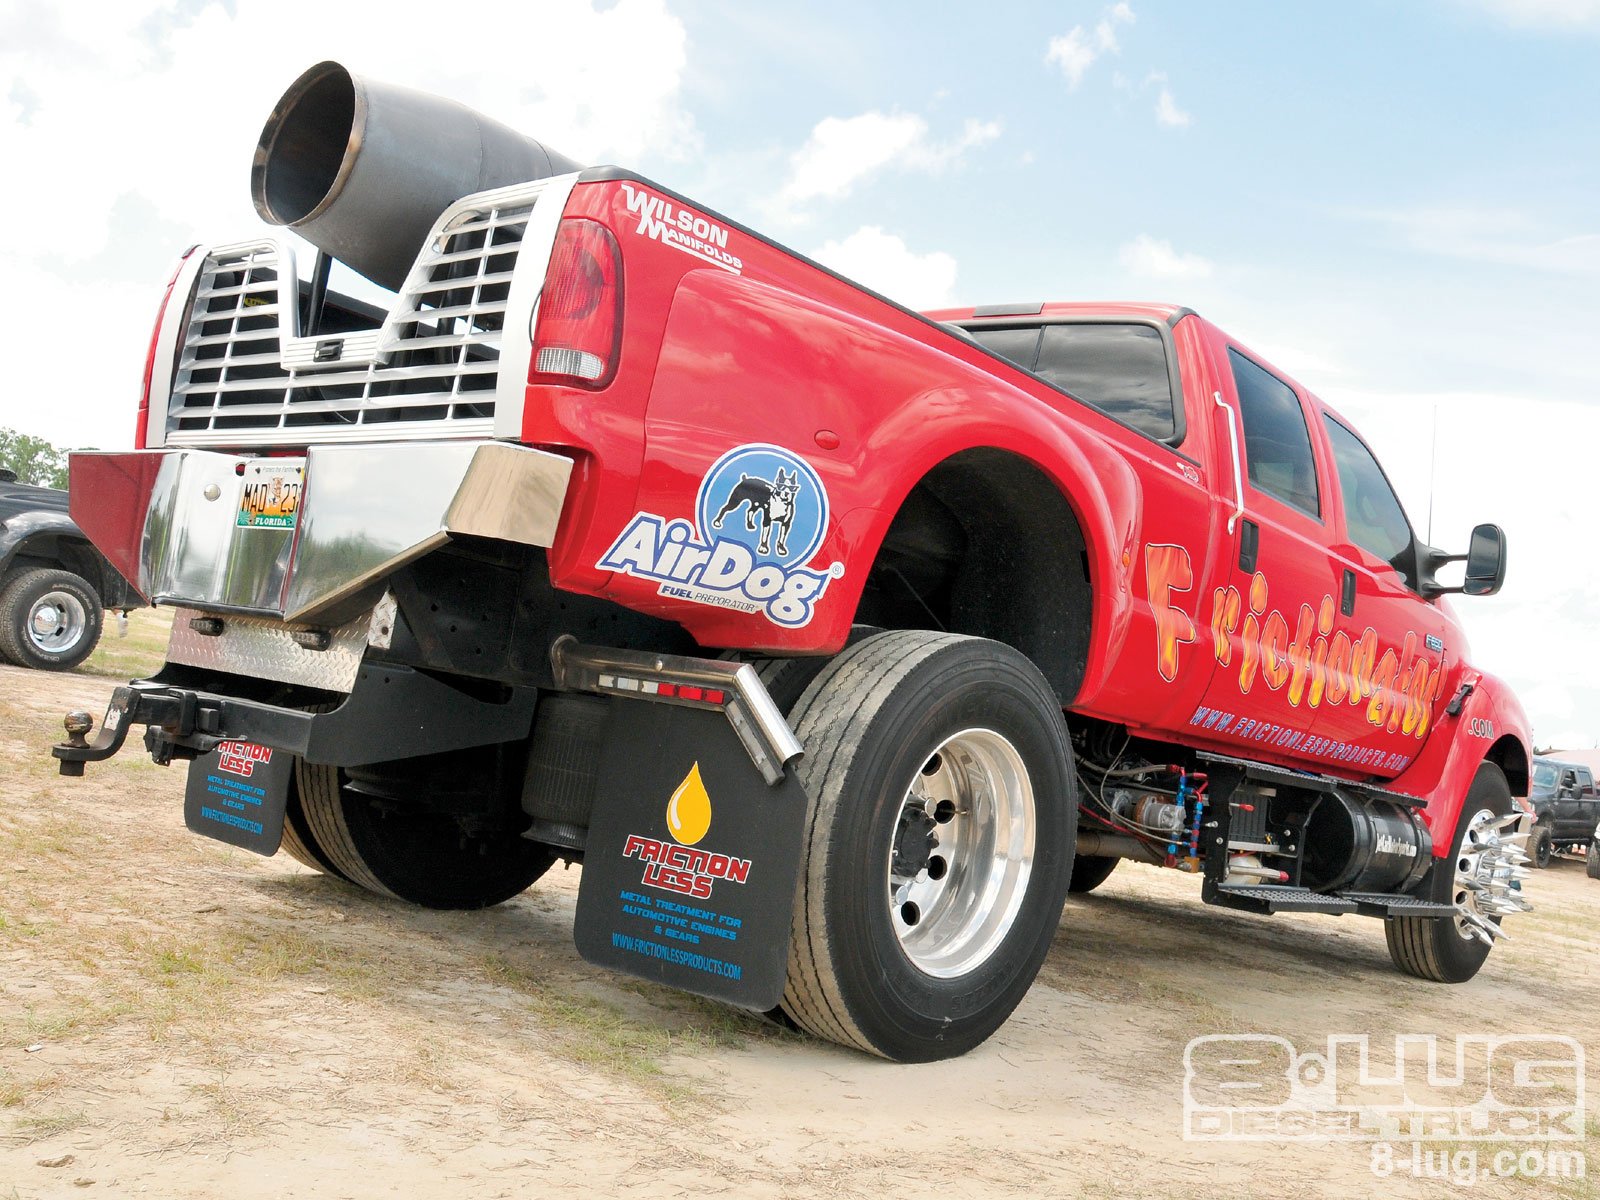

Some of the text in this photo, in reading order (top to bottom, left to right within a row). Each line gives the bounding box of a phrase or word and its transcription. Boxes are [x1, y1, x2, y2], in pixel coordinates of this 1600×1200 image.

[621, 184, 728, 248] WILSON
[636, 214, 743, 270] MANIFOLDS
[242, 483, 267, 512] MAD
[255, 516, 287, 527] FLORIDA
[661, 585, 755, 612] FUEL PREPORATOR
[1145, 543, 1448, 739] Frictionator
[1189, 705, 1410, 771] WWW.FRICTIONLESSPRODUCTS.COM
[218, 753, 254, 777] LESS
[622, 834, 752, 884] FRICTION
[641, 863, 714, 900] LESS
[620, 890, 743, 929] METAL TREATMENT FOR
[622, 904, 737, 941] AUTOMOTIVE ENGINES
[653, 925, 700, 945] & GEARS
[612, 932, 742, 981] WWW.FRICTIONLESSPRODUCTS.COM
